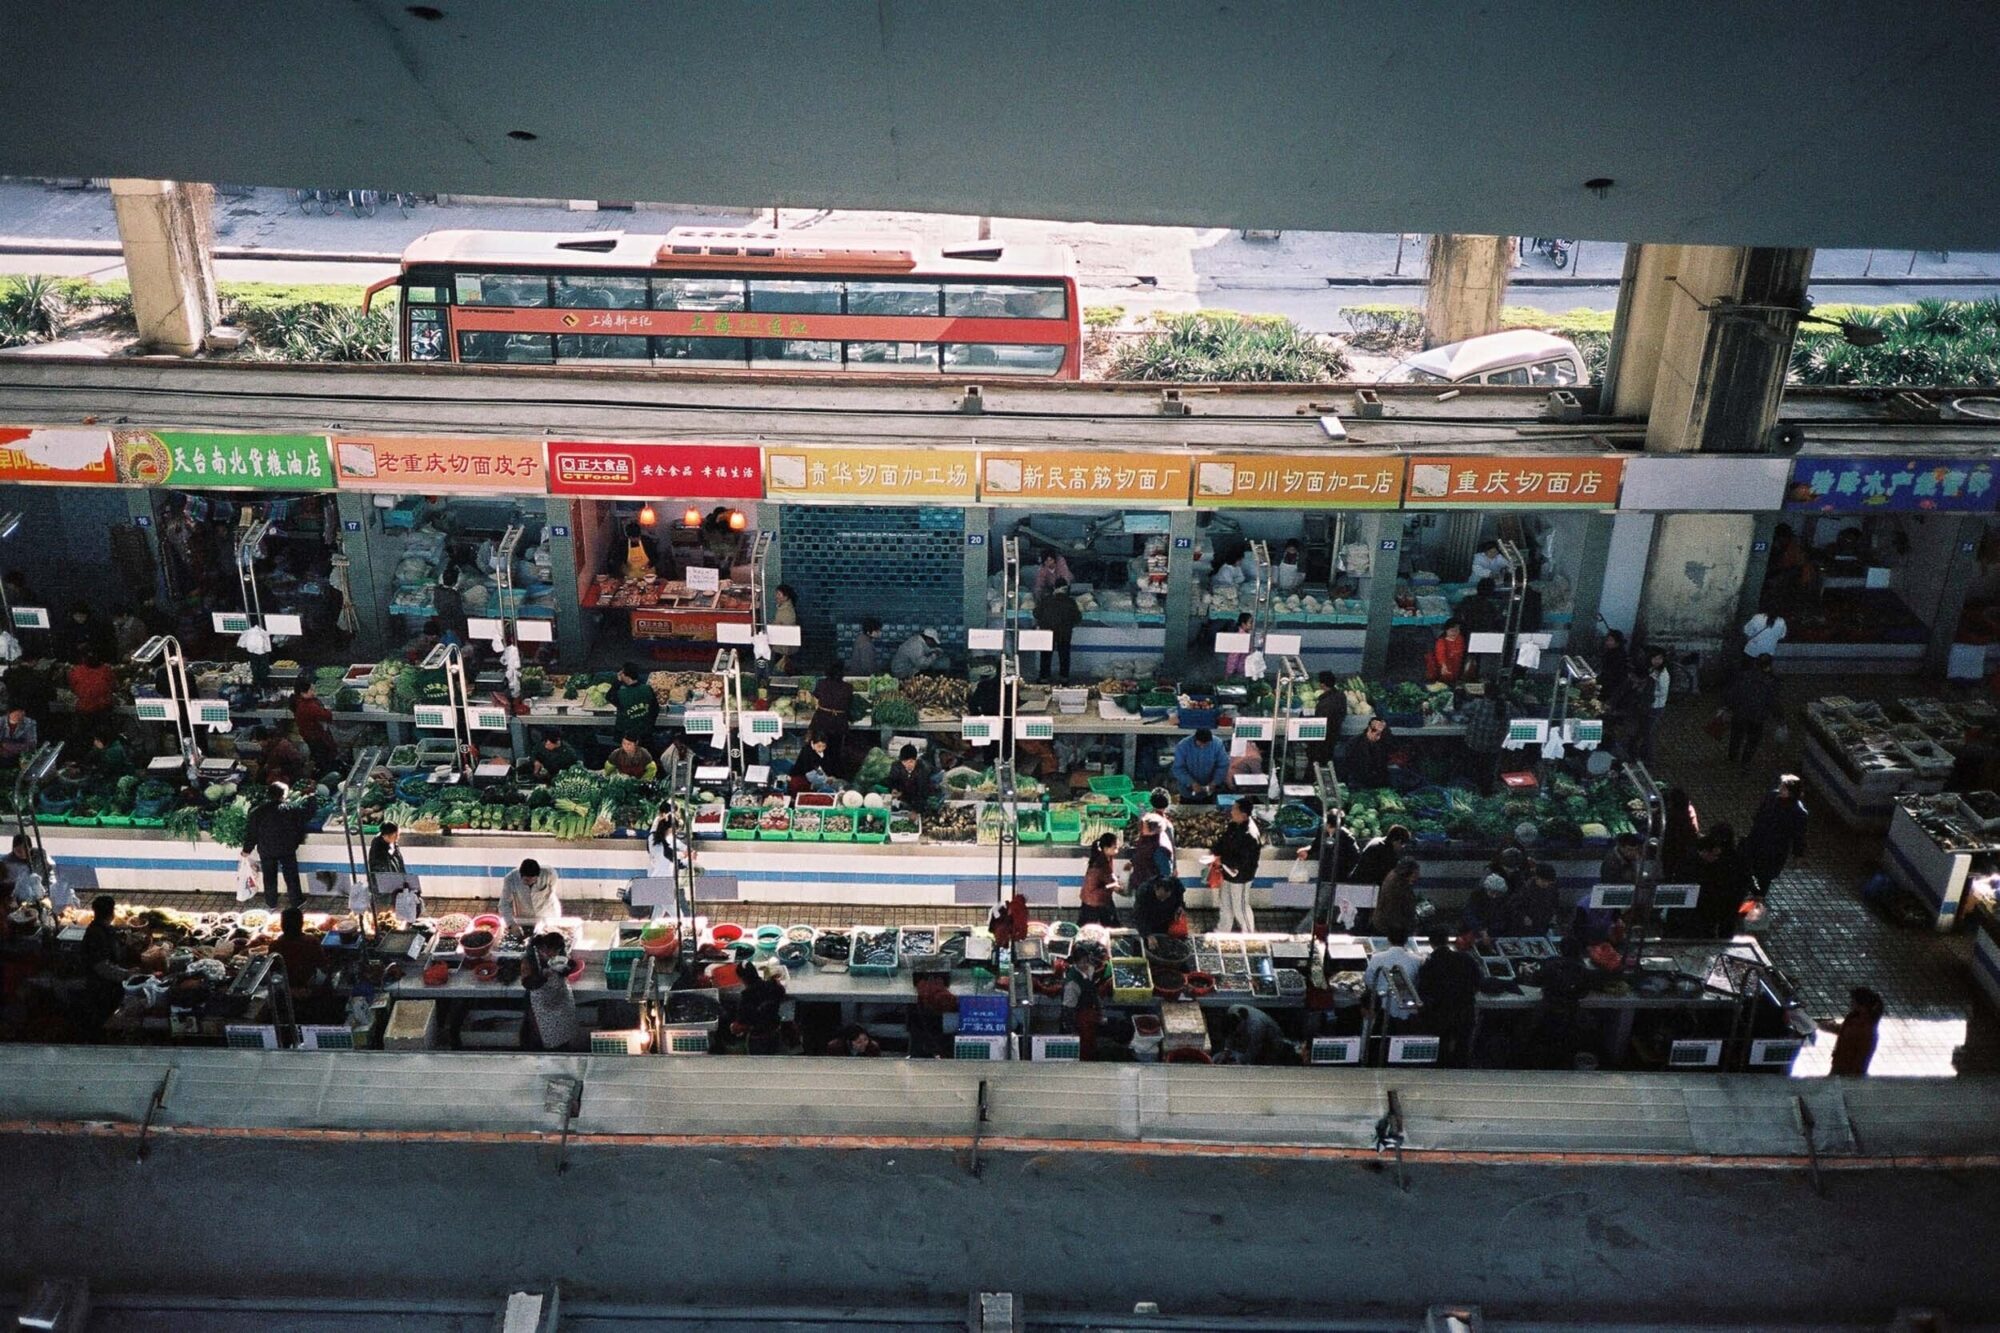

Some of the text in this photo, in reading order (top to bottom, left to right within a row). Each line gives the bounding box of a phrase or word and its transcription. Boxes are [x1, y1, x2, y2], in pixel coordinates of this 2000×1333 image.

[588, 313, 653, 332] 上海新世纪
[378, 451, 538, 477] 老重庆切面皮子
[577, 459, 629, 471] 正大食品
[641, 464, 754, 479] 安全食品 幸福生活
[809, 460, 968, 487] 贵华切面加工场
[1023, 464, 1181, 491] 新民高筋切面厂
[1236, 469, 1394, 493] 四川切面加工店
[1452, 469, 1603, 494] 重庆切面店
